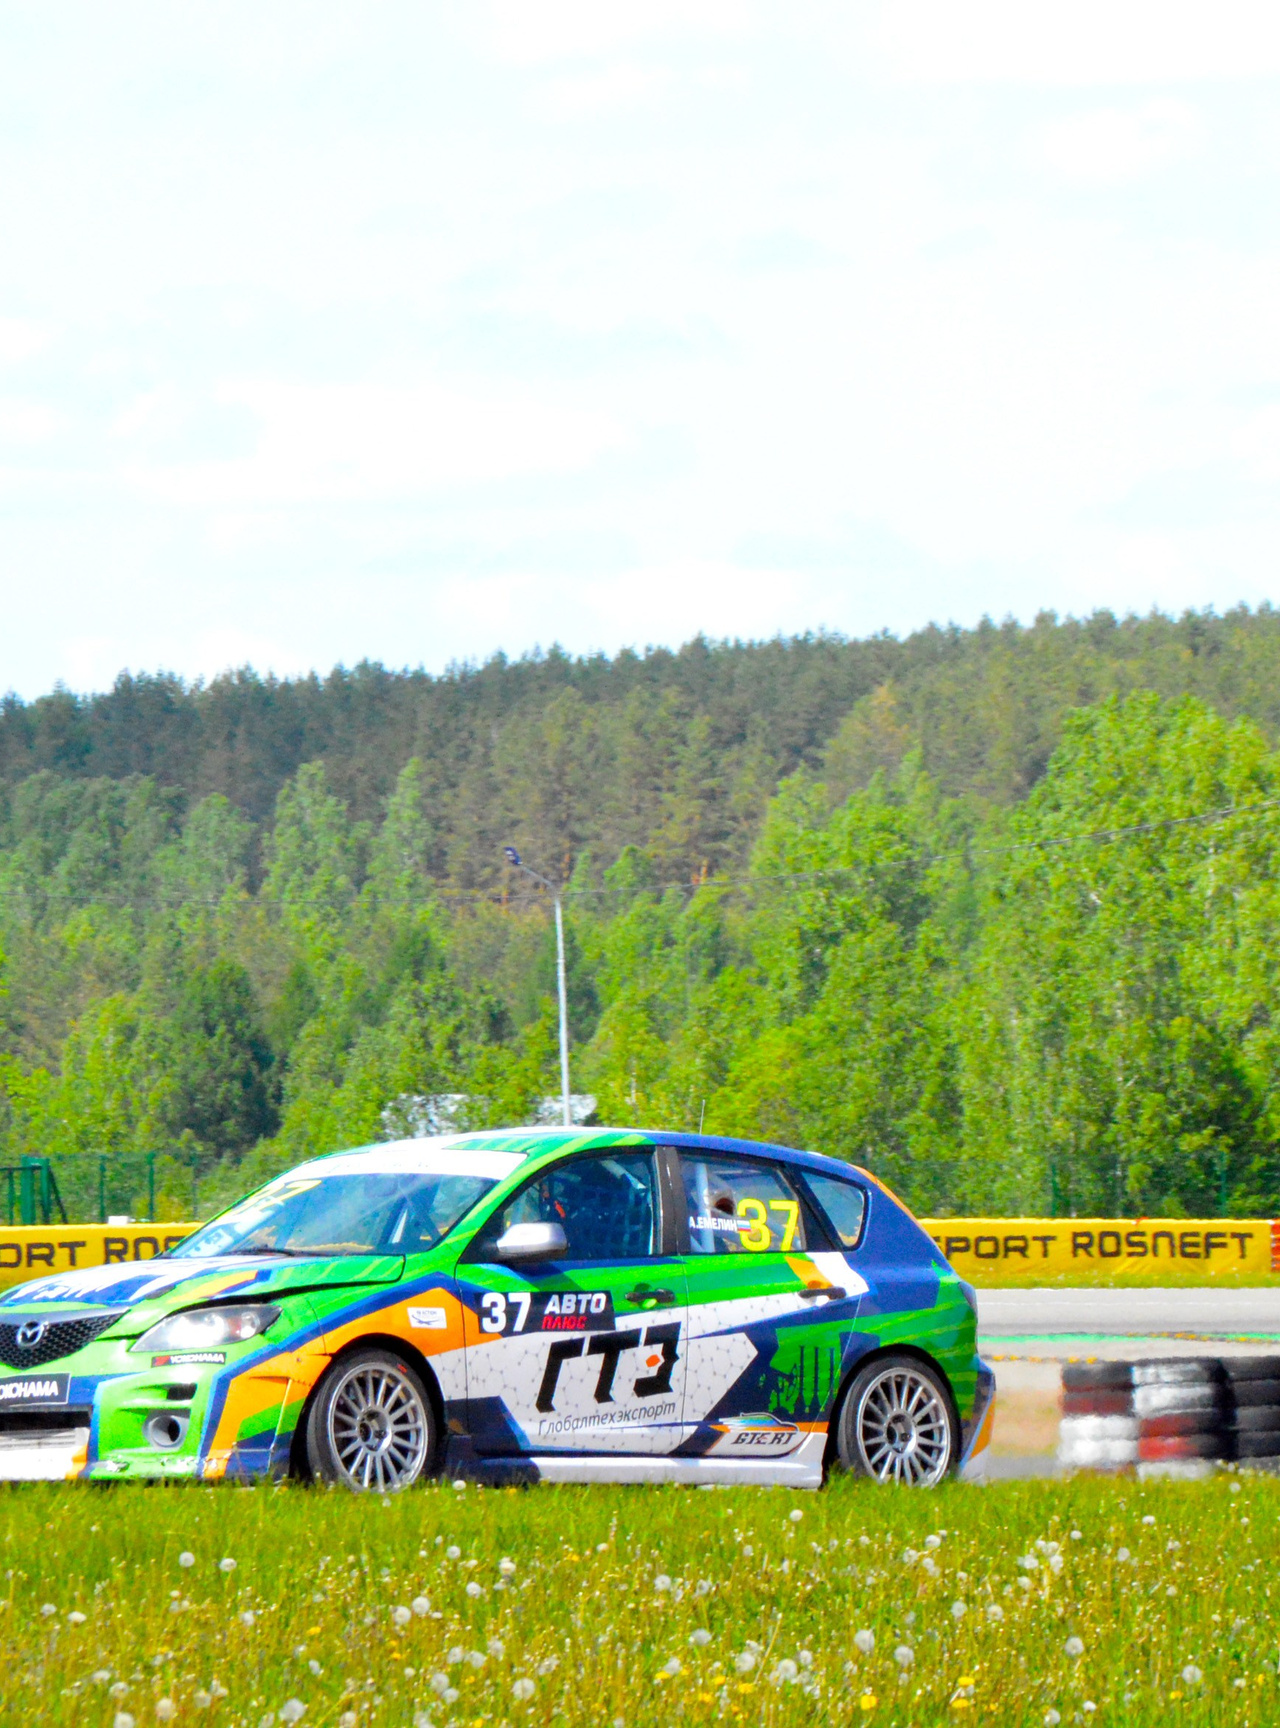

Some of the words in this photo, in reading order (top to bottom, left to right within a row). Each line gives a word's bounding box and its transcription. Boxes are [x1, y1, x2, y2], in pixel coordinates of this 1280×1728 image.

[736, 1197, 799, 1252] 37
[932, 1235, 1057, 1260] PORT
[481, 1291, 532, 1333] 37
[543, 1292, 607, 1315] АВТО
[541, 1315, 588, 1330] ПЛЮС
[171, 1352, 225, 1364] YOKOHAMA
[538, 1402, 676, 1436] Глобалтехэкспорт
